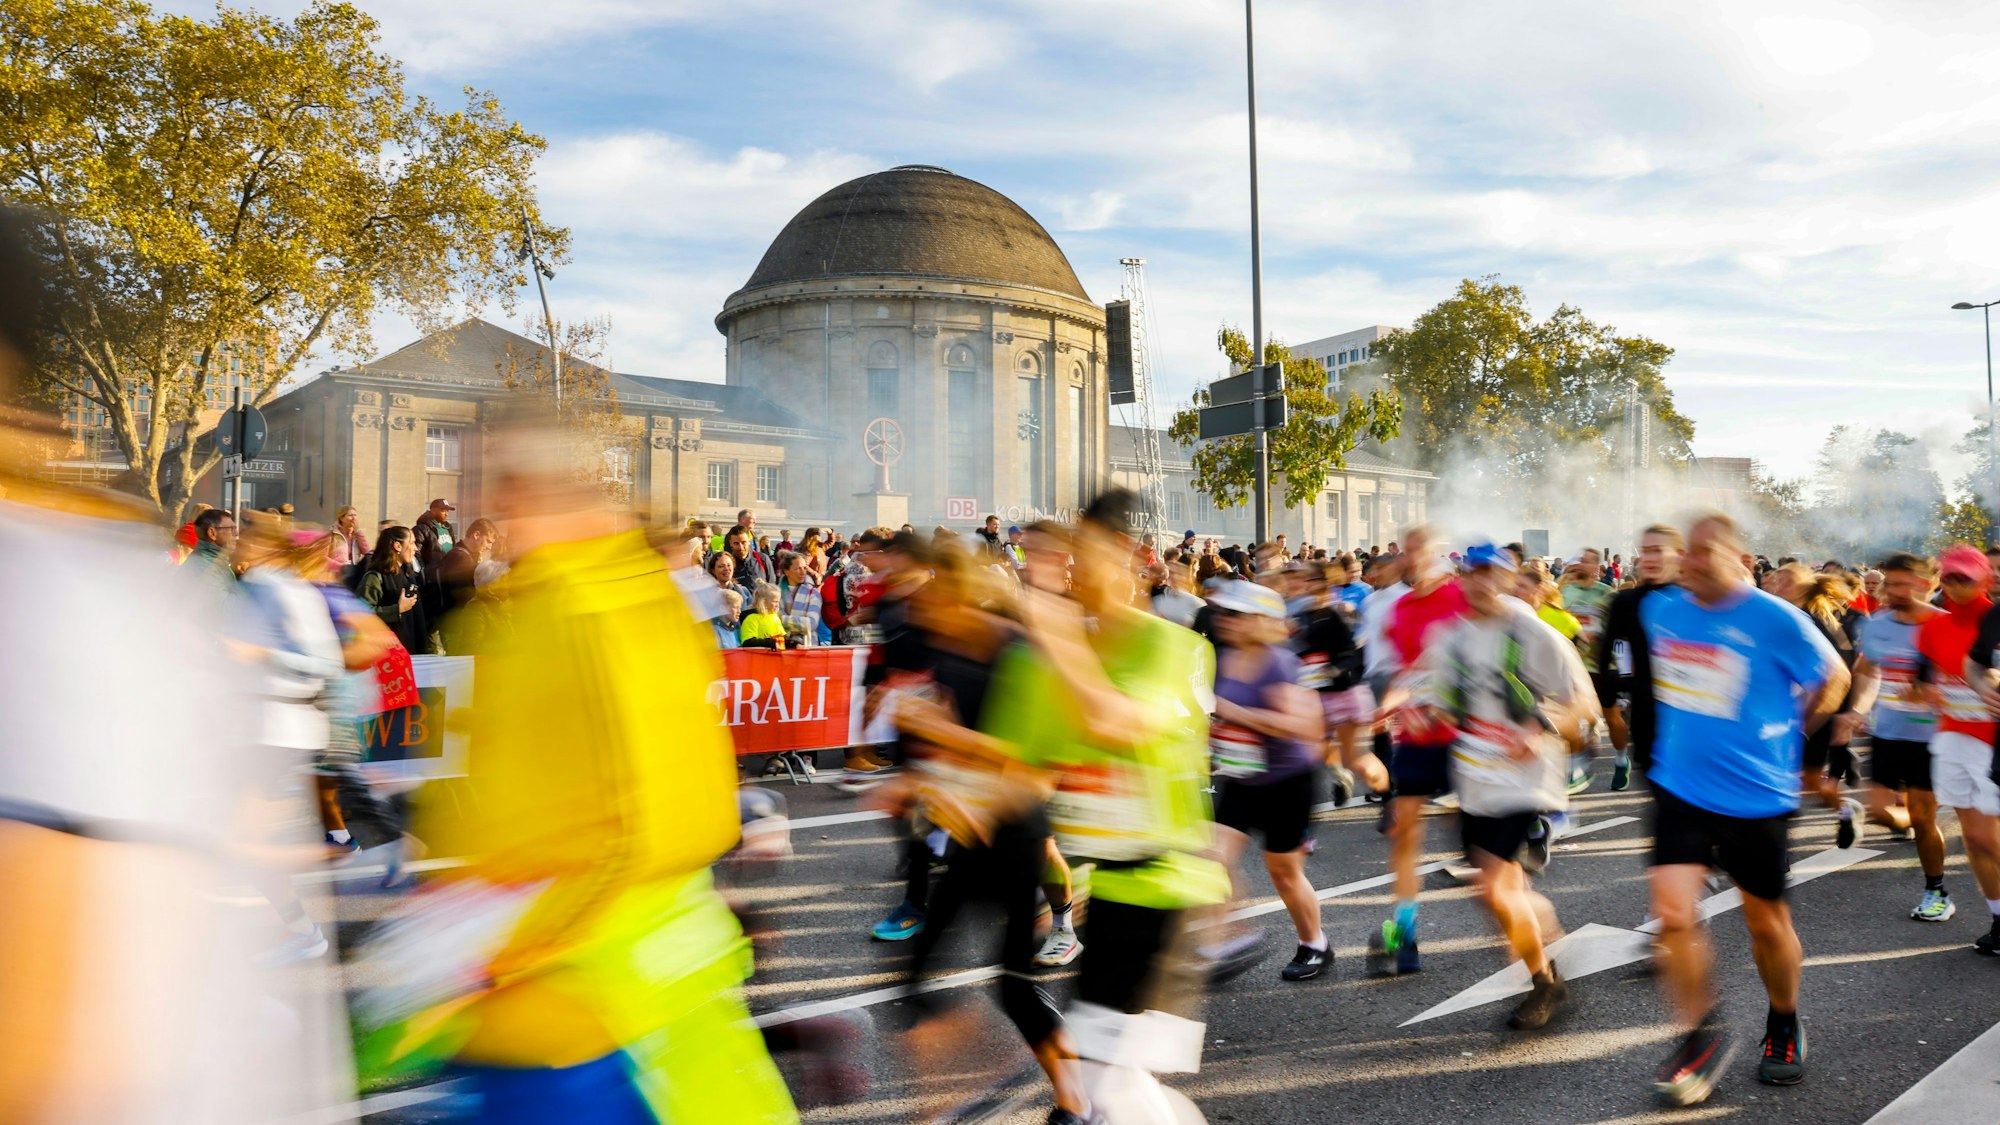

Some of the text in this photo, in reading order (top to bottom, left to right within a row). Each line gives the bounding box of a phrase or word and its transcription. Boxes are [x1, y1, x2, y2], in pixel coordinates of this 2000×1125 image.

[949, 500, 976, 517] DB
[995, 504, 1048, 523] KÖLN
[705, 676, 831, 726] ERALI
[361, 702, 429, 748] WB
